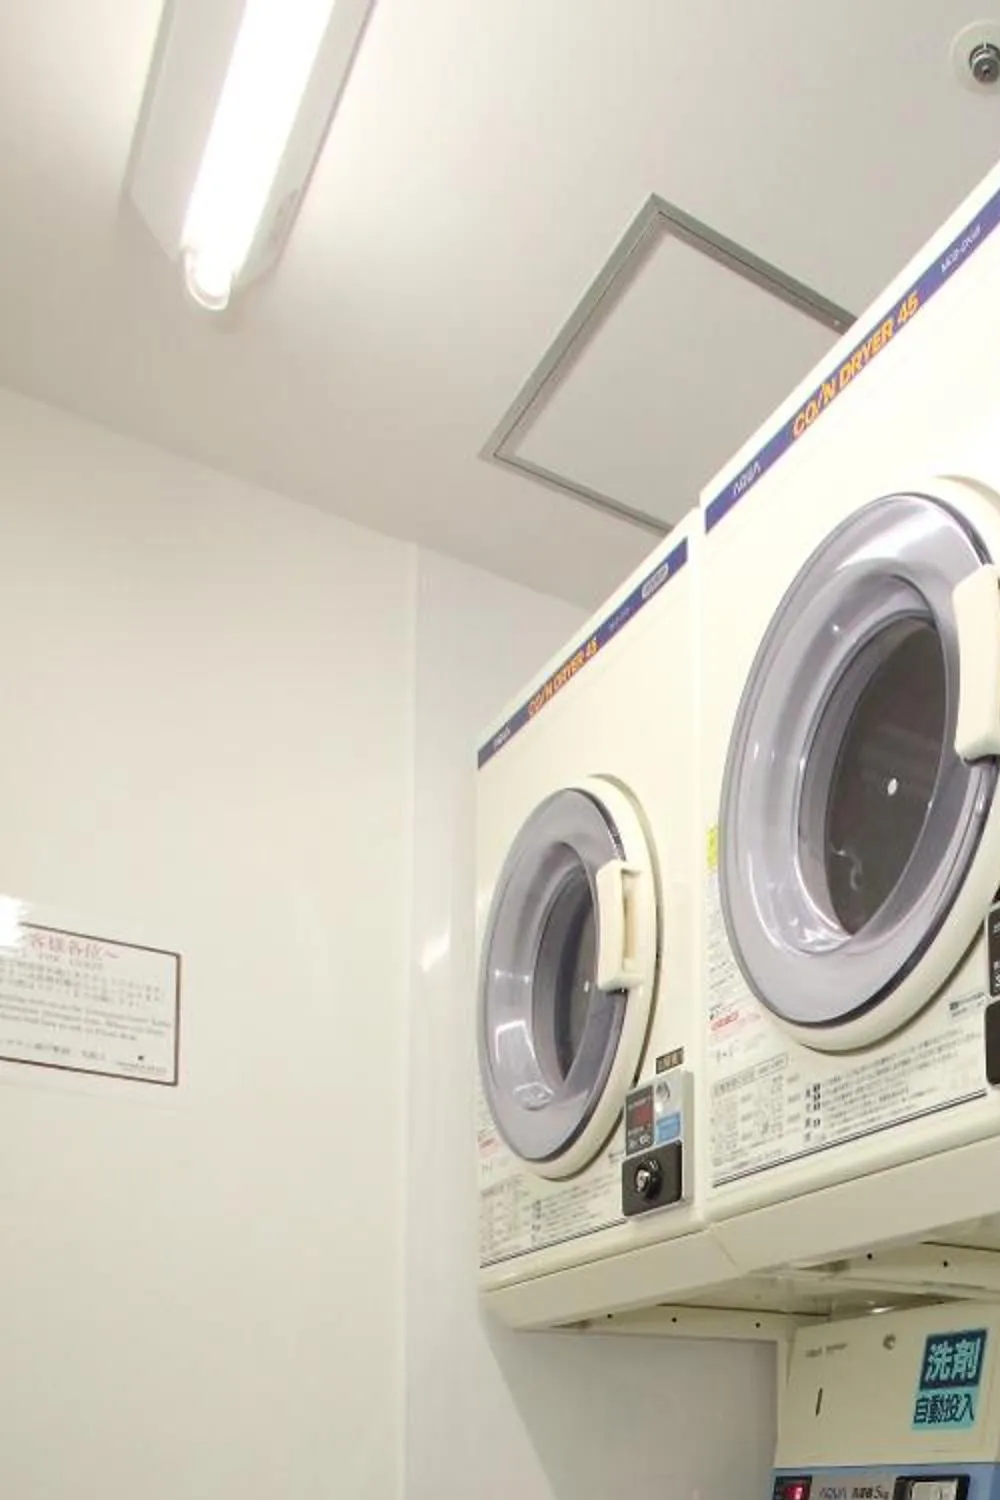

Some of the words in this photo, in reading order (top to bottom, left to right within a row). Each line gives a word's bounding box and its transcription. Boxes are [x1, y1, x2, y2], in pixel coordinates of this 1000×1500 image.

[839, 318, 895, 386] DRYER
[896, 290, 921, 327] 45
[924, 1336, 981, 1382] 洗剤
[913, 1393, 976, 1425] 自動投入
